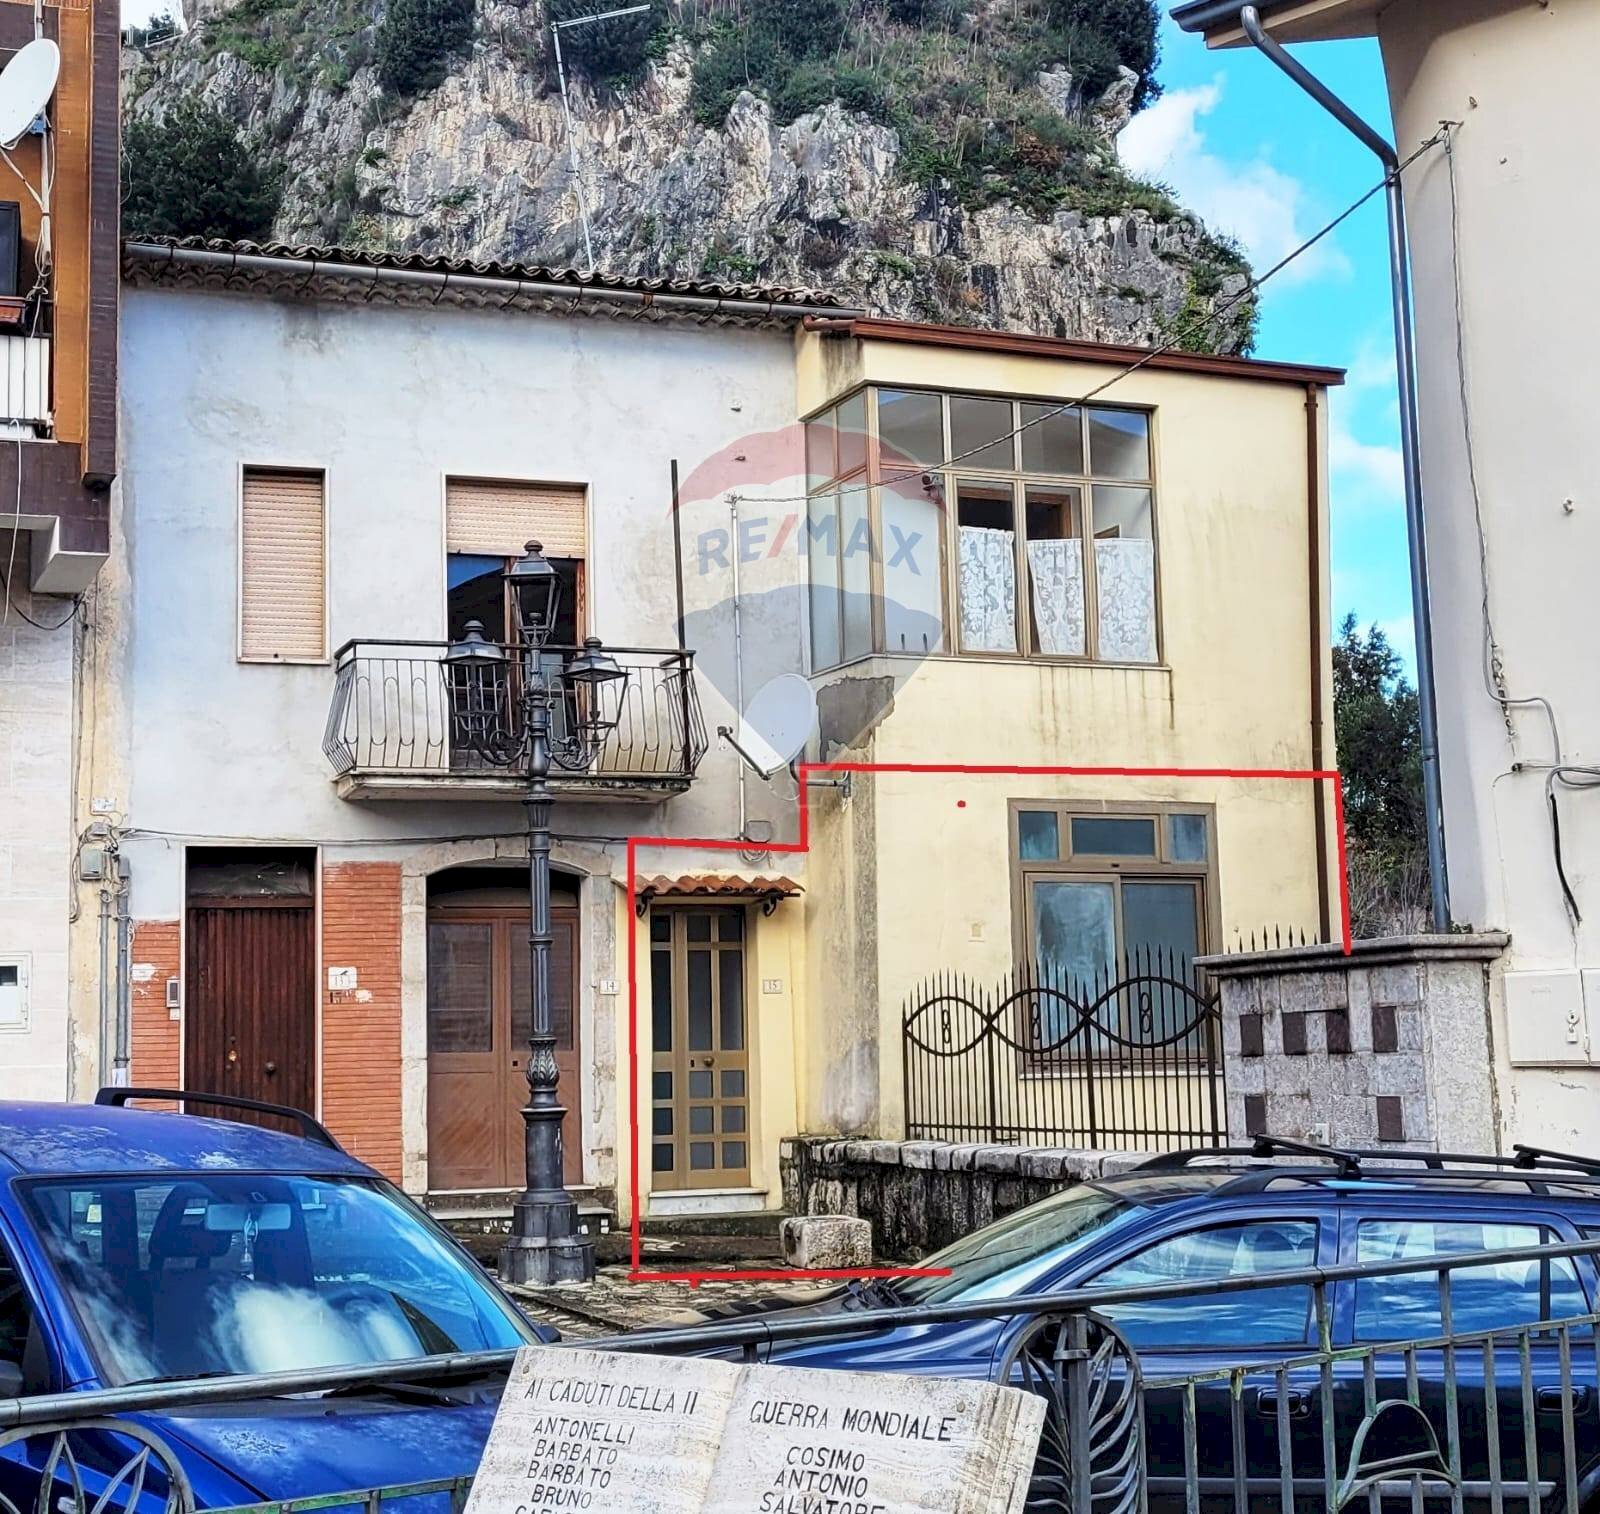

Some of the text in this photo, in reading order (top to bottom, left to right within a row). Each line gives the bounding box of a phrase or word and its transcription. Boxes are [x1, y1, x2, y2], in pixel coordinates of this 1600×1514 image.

[524, 1378, 698, 1415] AI CADUTI DELLA II
[533, 1417, 635, 1445] ANTONELLI
[749, 1400, 956, 1442] GUERRA MONDIALE
[534, 1439, 618, 1465] BARBATO
[786, 1446, 865, 1472] COSIMO
[527, 1461, 612, 1489] BARBATO
[774, 1469, 868, 1498] ANTONIO
[531, 1484, 592, 1509] BRUNO
